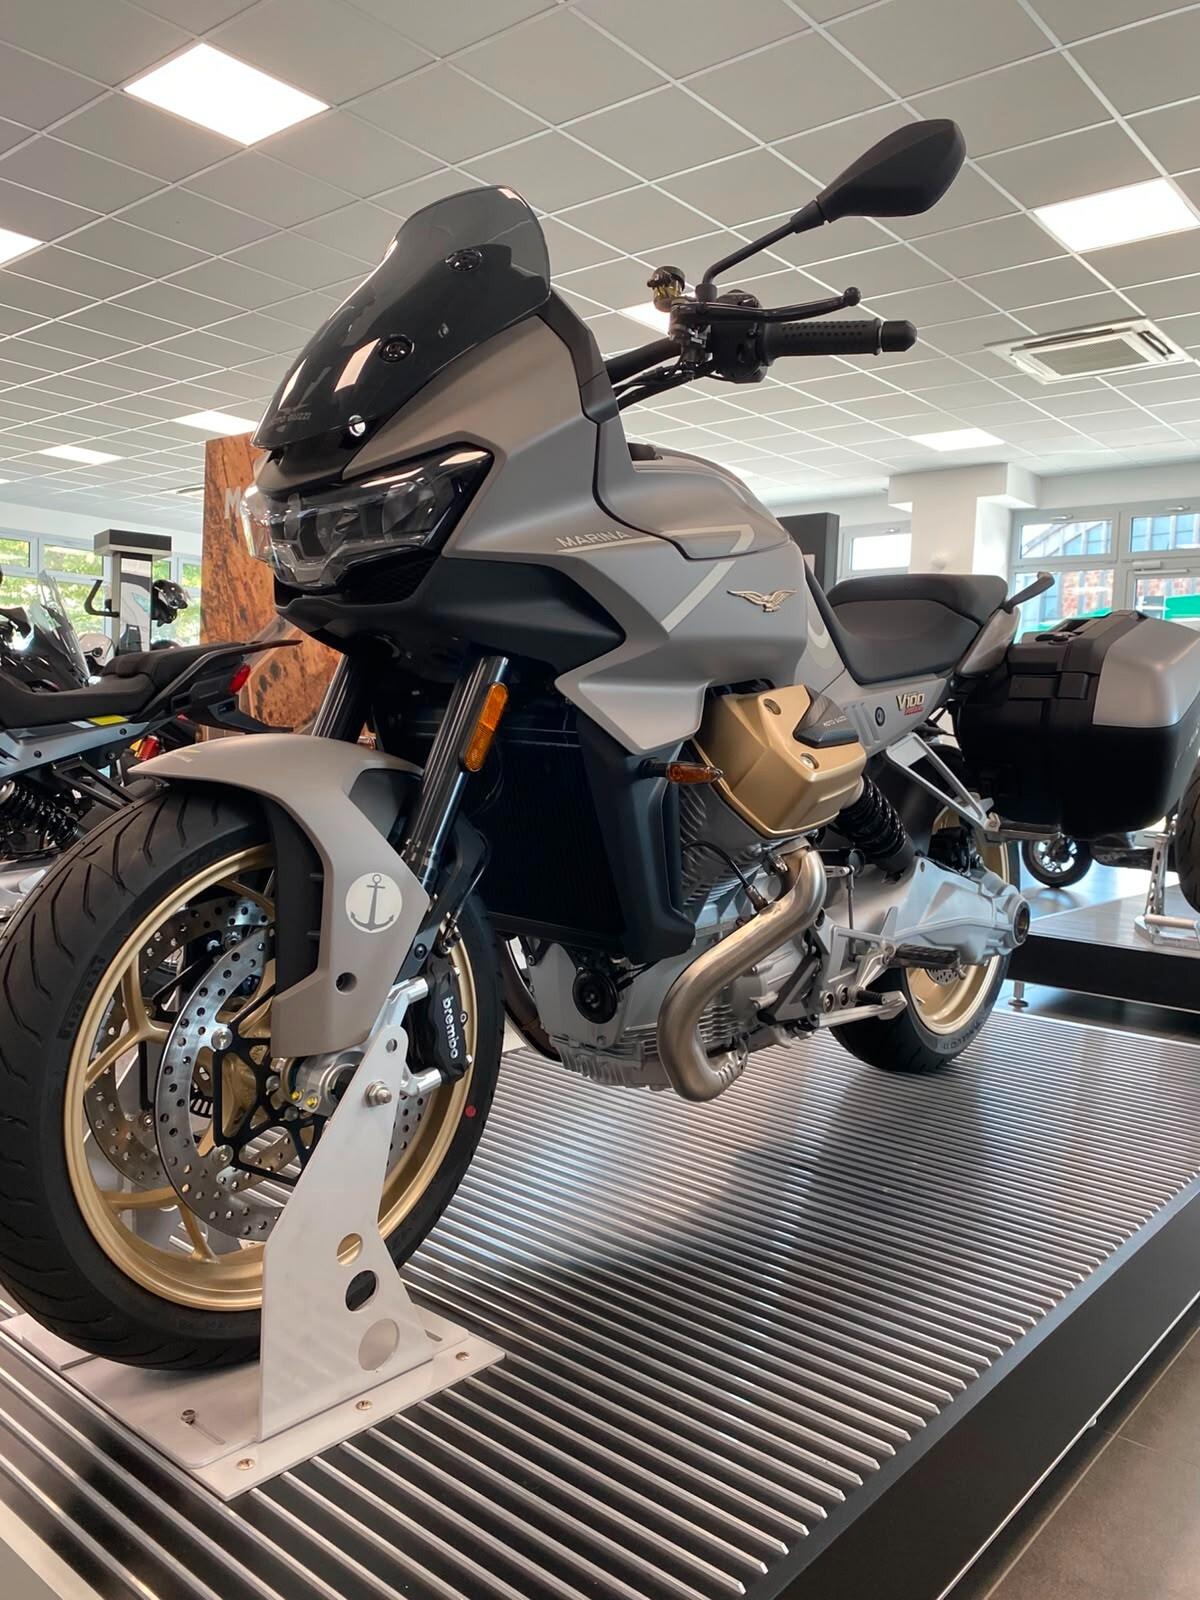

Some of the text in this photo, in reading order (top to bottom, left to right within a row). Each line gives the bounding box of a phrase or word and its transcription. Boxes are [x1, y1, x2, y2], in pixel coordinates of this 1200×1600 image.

[555, 530, 632, 548] MARINA
[896, 692, 925, 711] V100
[442, 996, 460, 1059] brembo
